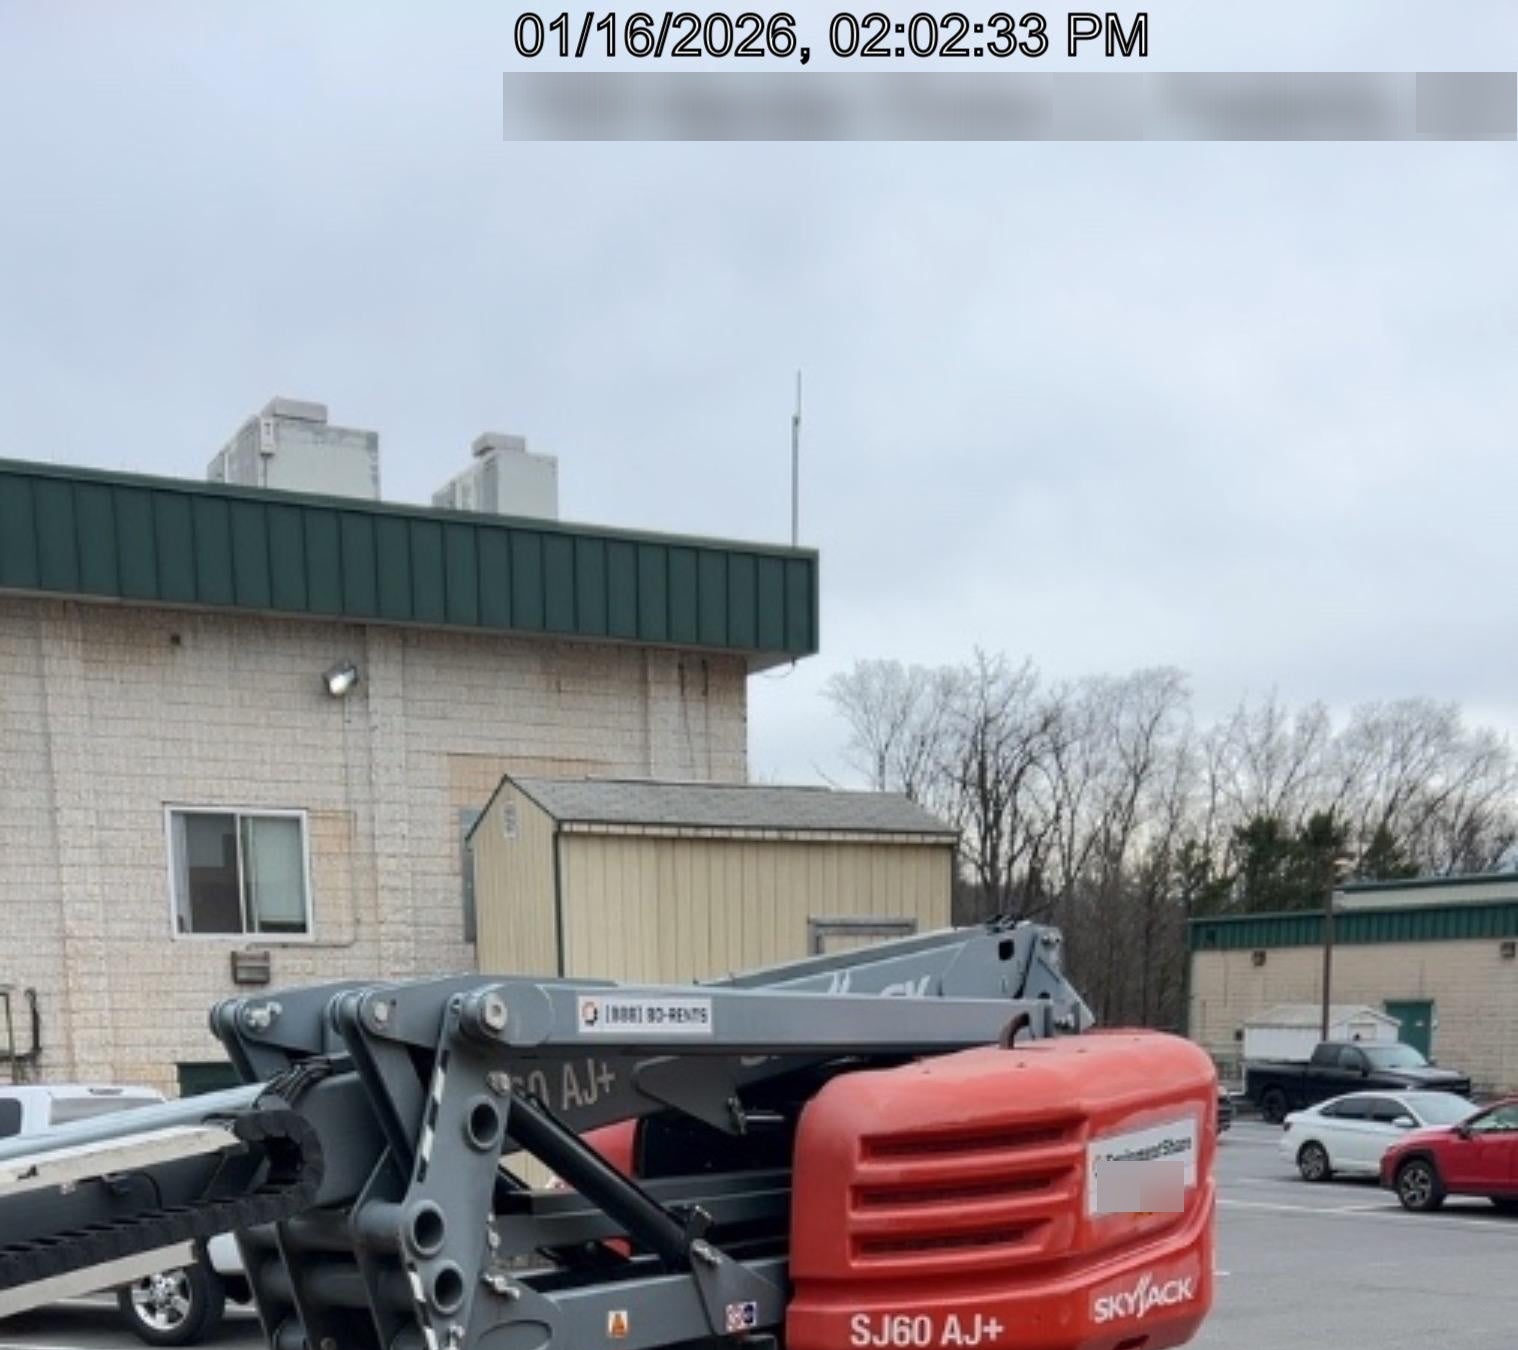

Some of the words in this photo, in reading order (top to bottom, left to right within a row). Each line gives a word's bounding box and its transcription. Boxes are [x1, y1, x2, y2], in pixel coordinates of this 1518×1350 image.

[562, 1057, 615, 1110] AJ+
[1094, 1272, 1194, 1324] SKYJACK
[850, 1313, 931, 1347] SJ60
[940, 1313, 1005, 1347] AJ+
